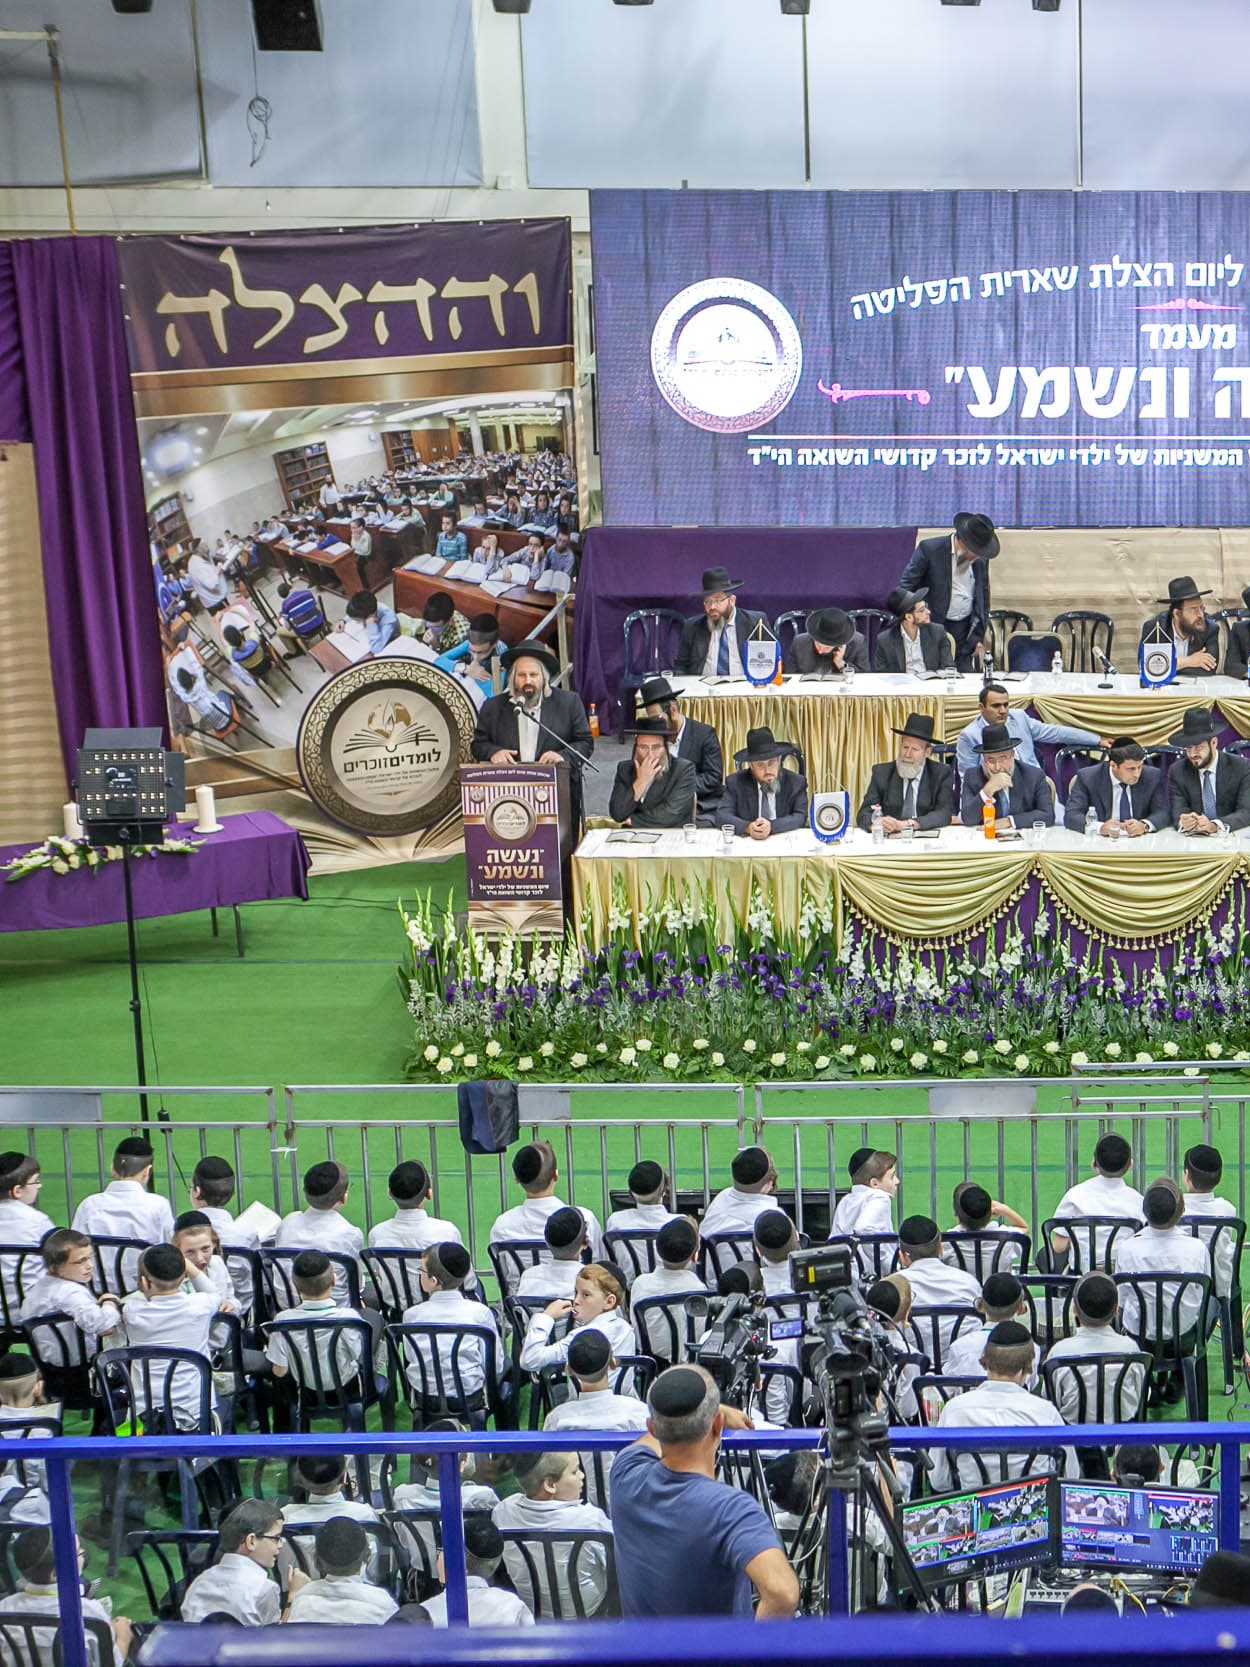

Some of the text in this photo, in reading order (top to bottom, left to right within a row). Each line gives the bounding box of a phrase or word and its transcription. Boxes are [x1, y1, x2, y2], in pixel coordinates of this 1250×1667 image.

[979, 265, 1079, 298] שארית
[1088, 254, 1174, 293] הצלת
[1185, 253, 1244, 293] ליום
[157, 246, 541, 358] וההצלה
[850, 275, 971, 320] הפליטה
[1140, 323, 1238, 350] מעמד
[797, 448, 869, 466] השואה
[874, 448, 937, 471] קדושי
[941, 442, 992, 466] לזכר
[995, 442, 1065, 466] ישראל
[1069, 442, 1111, 466] ילדי
[1114, 442, 1149, 466] של
[1153, 448, 1243, 466] המשניות
